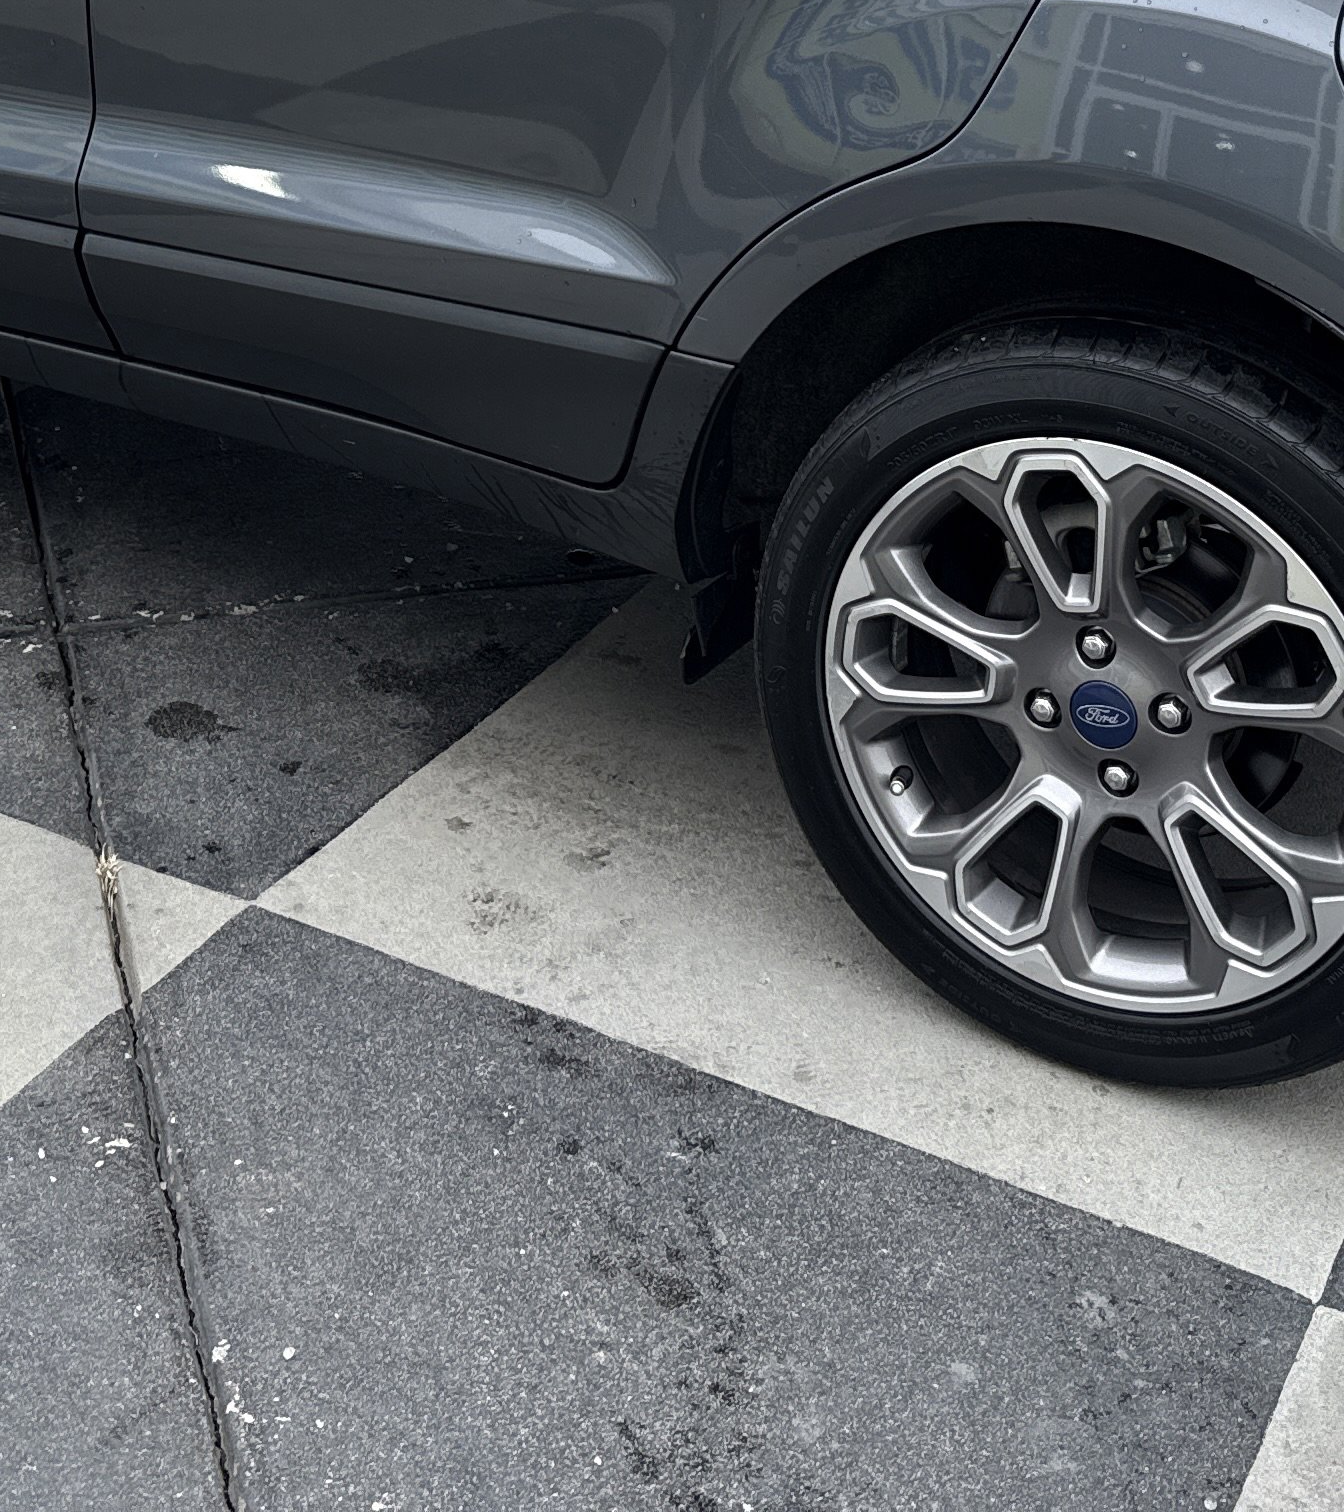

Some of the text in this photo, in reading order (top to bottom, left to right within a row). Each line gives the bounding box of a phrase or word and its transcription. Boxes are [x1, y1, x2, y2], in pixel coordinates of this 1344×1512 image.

[1185, 411, 1259, 457] OUTSIDE
[775, 476, 836, 596] SAILUN
[1085, 707, 1119, 724] Ford
